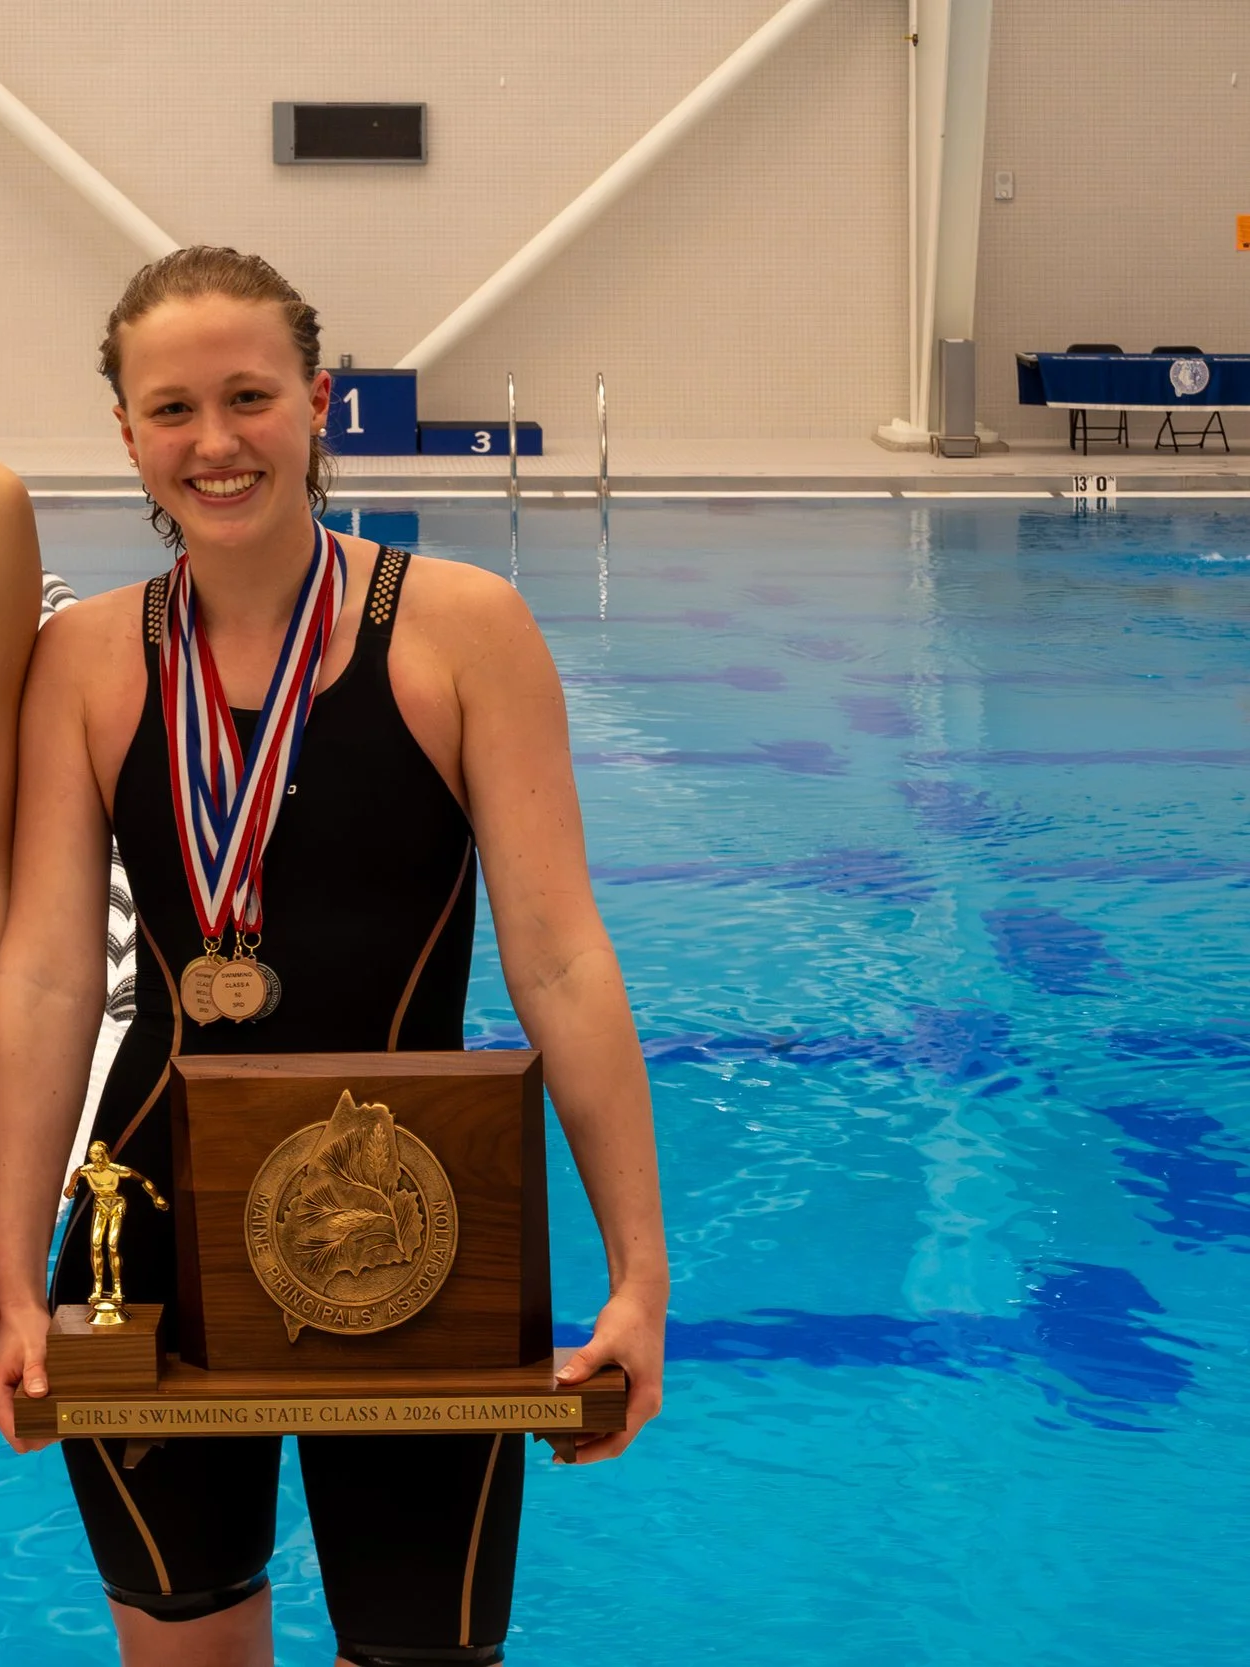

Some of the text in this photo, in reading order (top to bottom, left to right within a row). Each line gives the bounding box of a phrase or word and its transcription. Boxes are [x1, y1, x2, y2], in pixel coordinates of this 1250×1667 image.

[343, 388, 364, 433] 1
[471, 430, 491, 453] 3
[1074, 475, 1087, 492] 13
[1096, 476, 1107, 492] 0
[251, 1192, 273, 1257] MAINE
[388, 1200, 450, 1320] ASSOCIATION
[70, 1402, 570, 1426] GIRLS' SWIMMING STATE CLASS A 2026 CHAMPIONS
